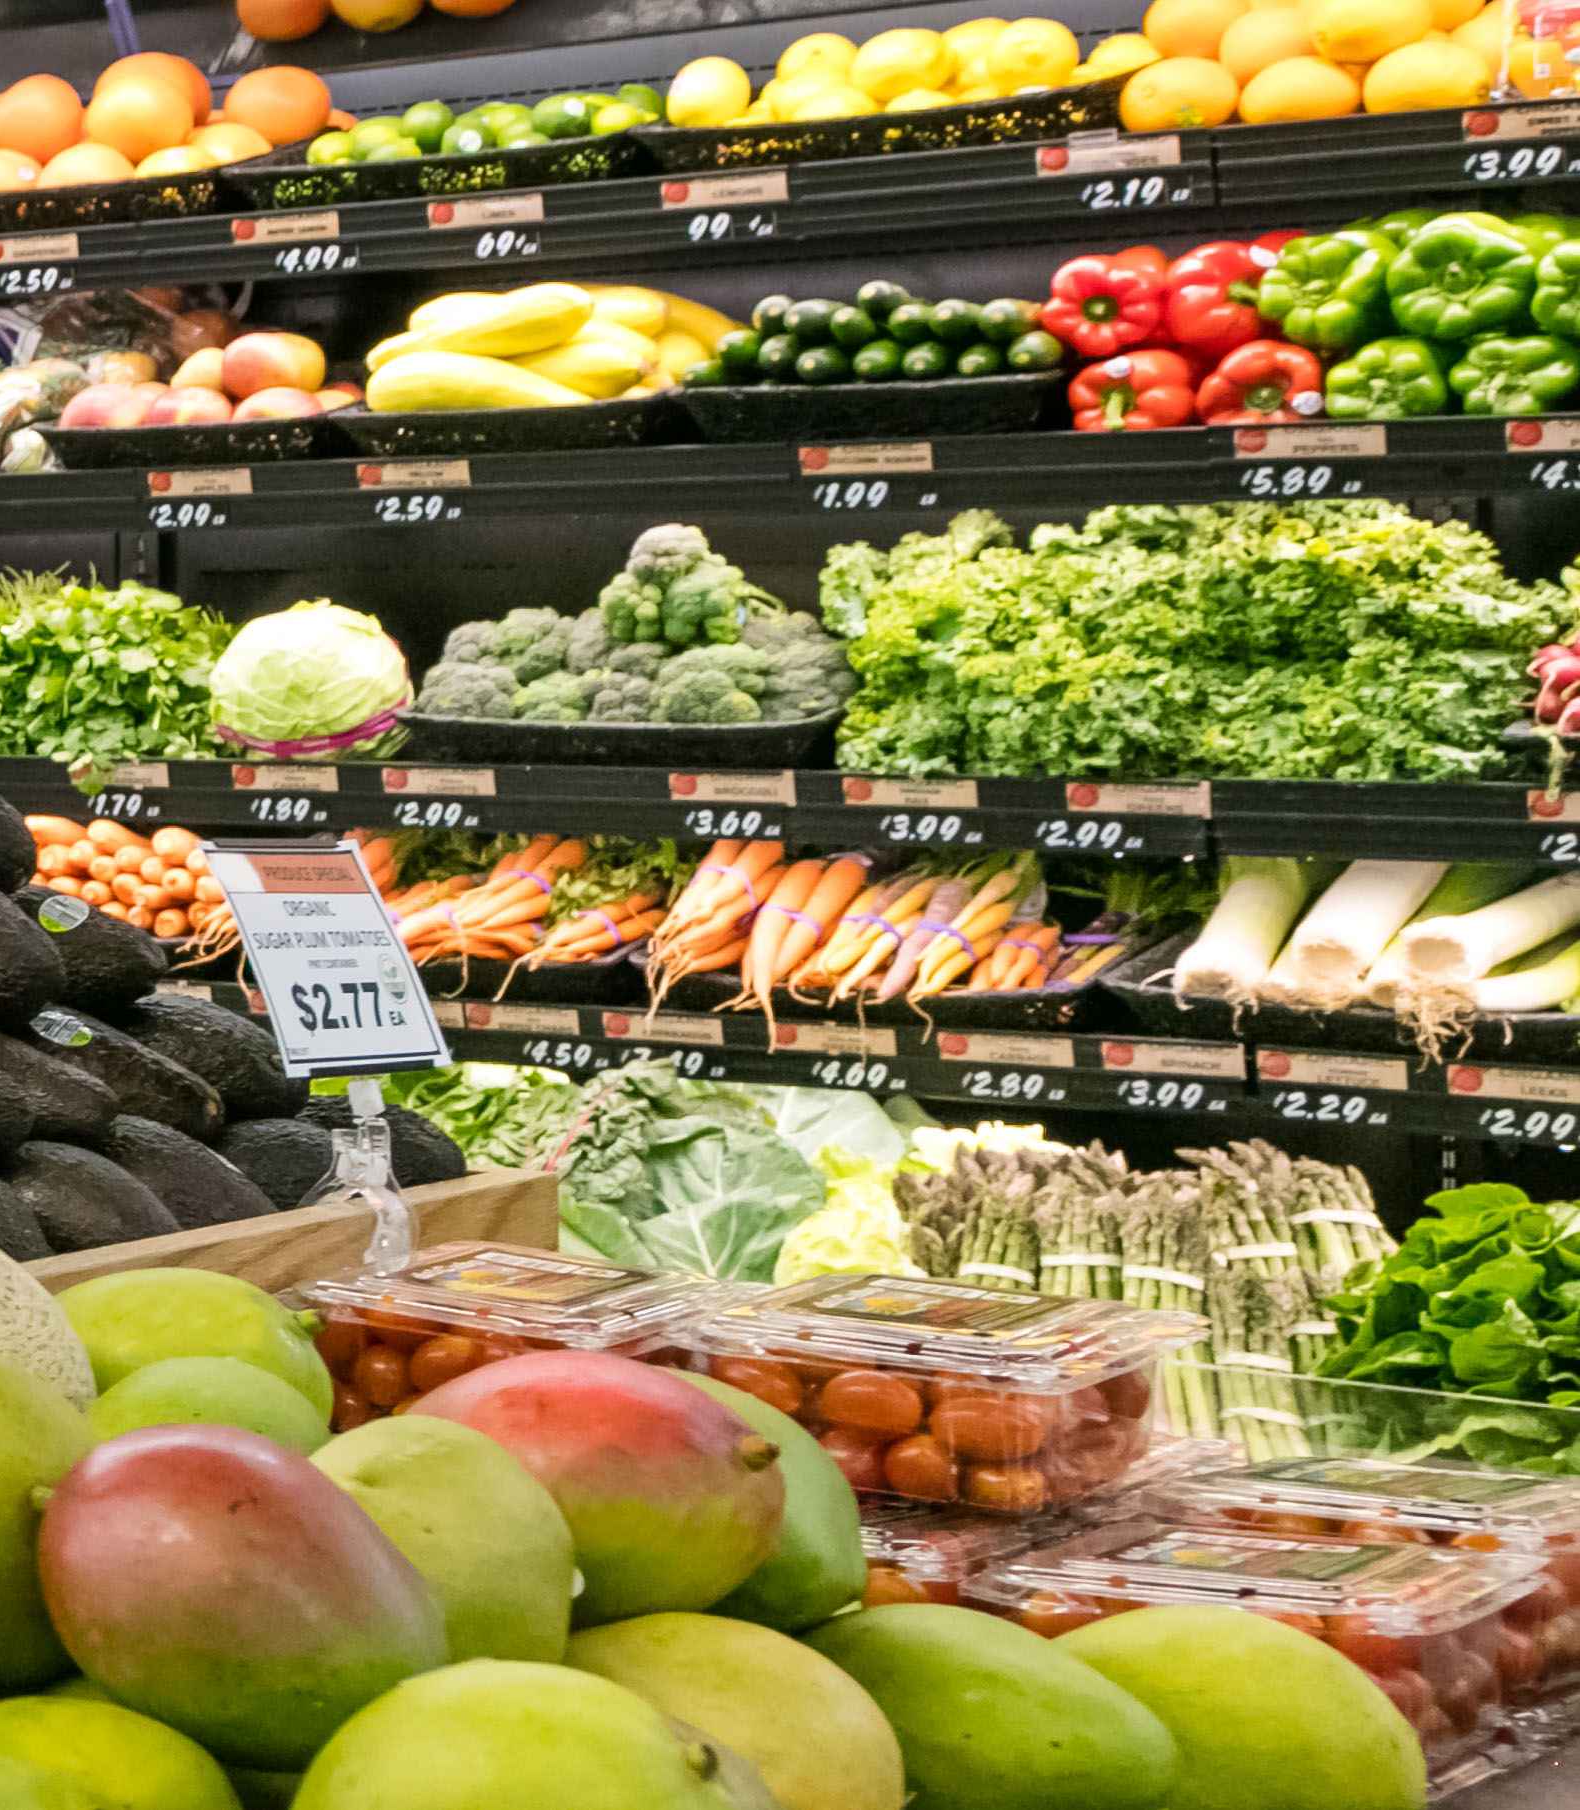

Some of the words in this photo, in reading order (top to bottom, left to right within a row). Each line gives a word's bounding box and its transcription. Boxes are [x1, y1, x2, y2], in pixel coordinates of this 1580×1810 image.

[1464, 145, 1562, 180] $3.99
[1081, 176, 1164, 209] $2.19
[1240, 465, 1332, 496] $5.89
[879, 814, 962, 842] $3.99
[1036, 820, 1123, 849] $2.99
[252, 931, 292, 950] SUGAR
[293, 931, 330, 948] PLUM
[327, 930, 392, 947] TOMATOES
[291, 981, 383, 1036] $2.77
[389, 1010, 407, 1026] EA
[1117, 1079, 1204, 1110] $3.99
[1273, 1090, 1367, 1124] $2.29
[1479, 1107, 1577, 1141] $2.99
